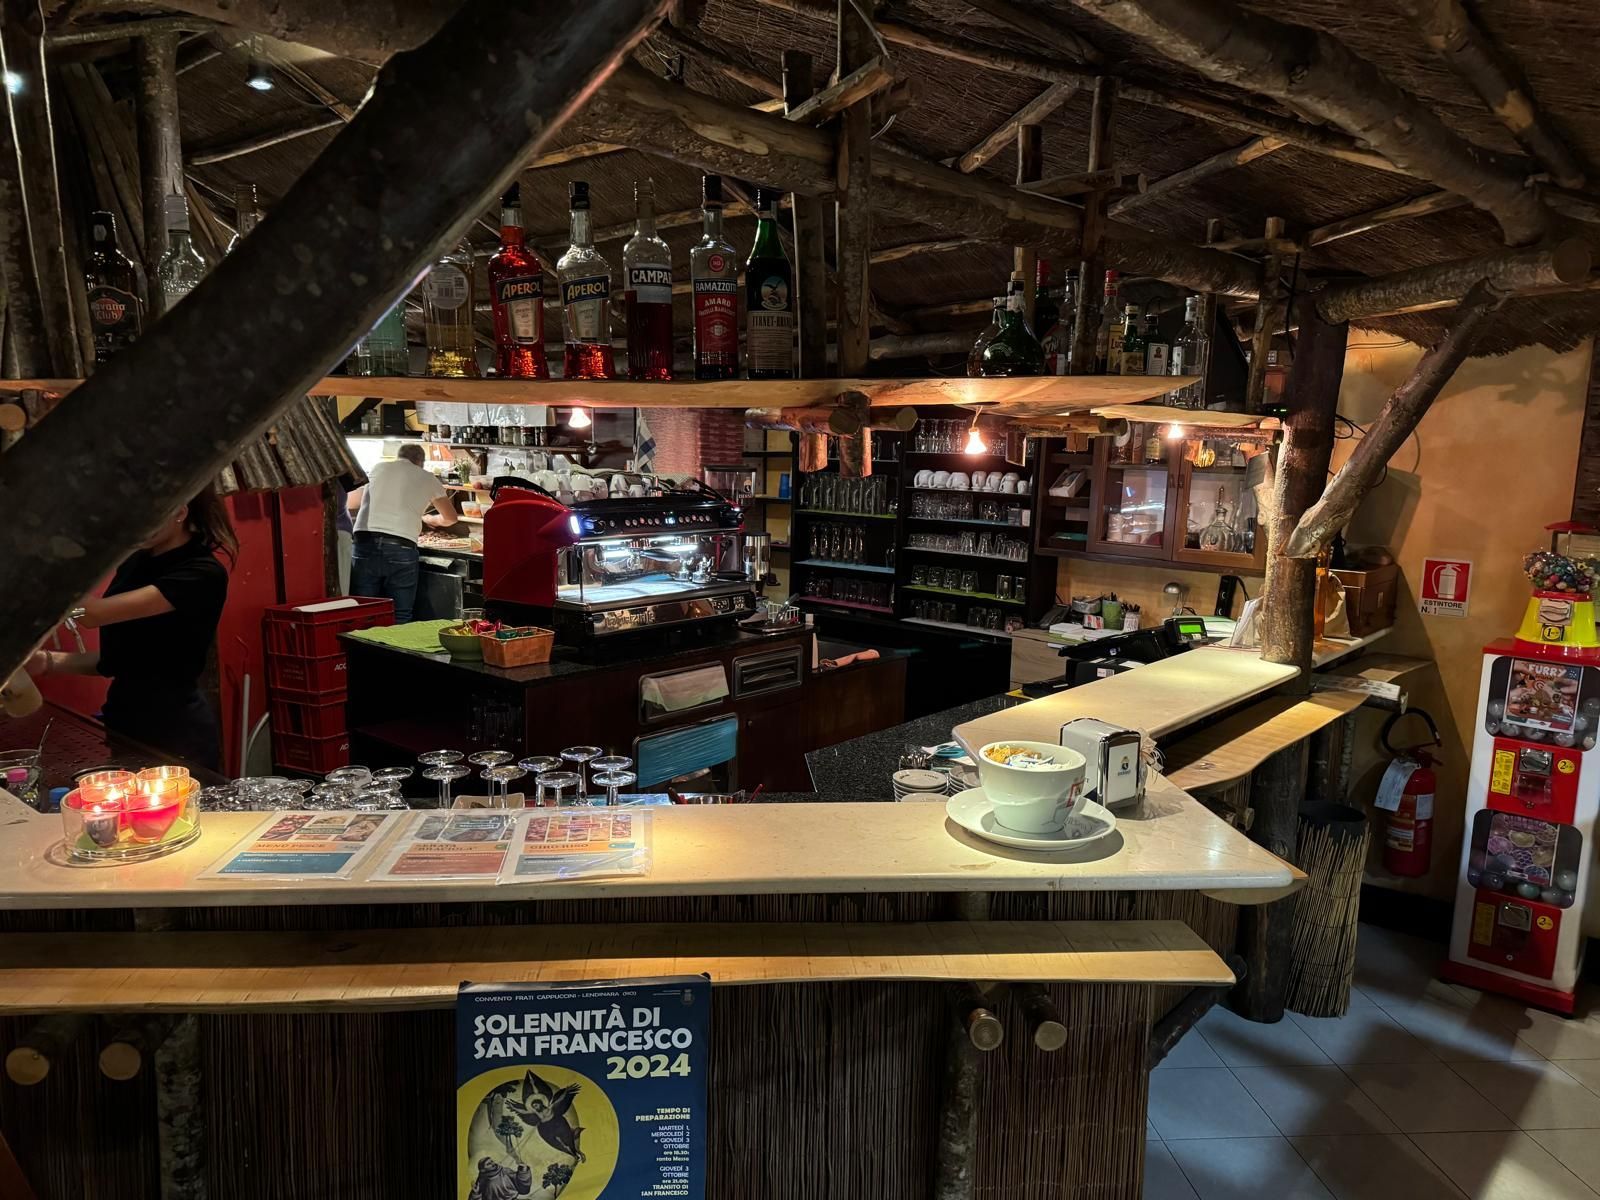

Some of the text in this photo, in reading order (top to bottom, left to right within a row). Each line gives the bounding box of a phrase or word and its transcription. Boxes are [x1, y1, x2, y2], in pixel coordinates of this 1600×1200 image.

[502, 281, 540, 300] APEROL
[567, 282, 606, 300] APEROL
[704, 297, 732, 308] AMARO
[1424, 600, 1462, 608] ESTINTORE
[1528, 664, 1567, 678] FURRY
[474, 1003, 660, 1036] SOLENNITÀ DI
[474, 1028, 692, 1060] SAN FRANCESCO
[606, 1052, 692, 1080] 2024
